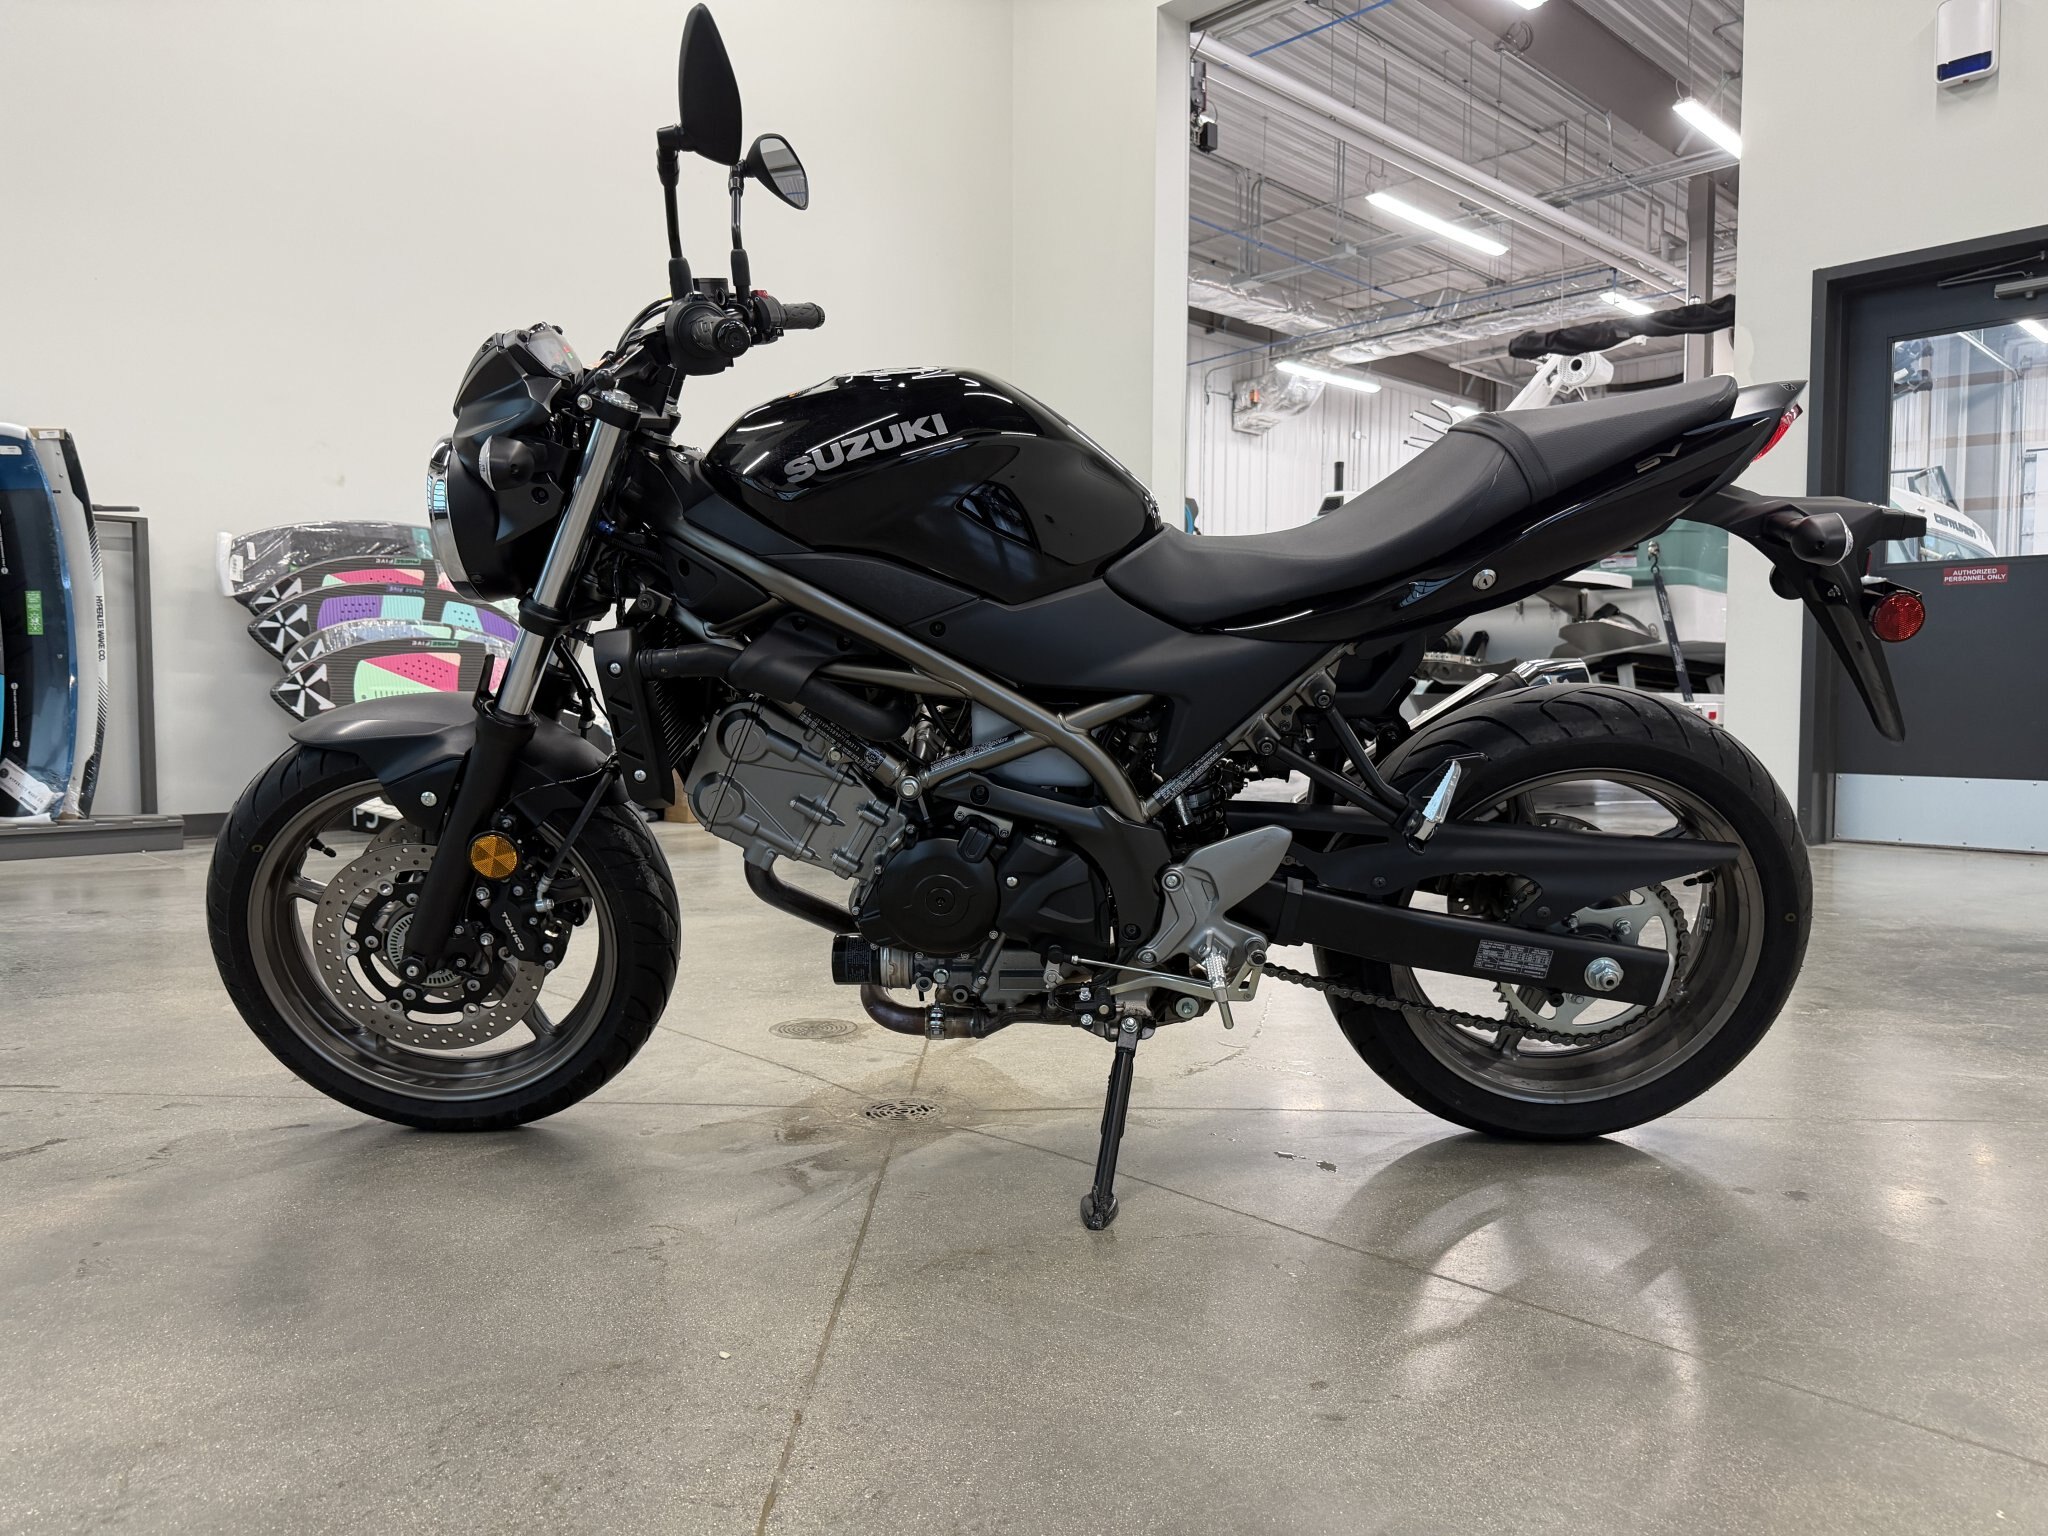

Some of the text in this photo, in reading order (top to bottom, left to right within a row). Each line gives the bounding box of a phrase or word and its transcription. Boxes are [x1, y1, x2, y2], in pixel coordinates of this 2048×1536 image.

[783, 413, 949, 484] SUZUKI
[1634, 442, 1684, 474] SV
[96, 595, 105, 629] HYPERLITE
[97, 629, 106, 650] WAKE
[501, 911, 525, 952] TOKICO
